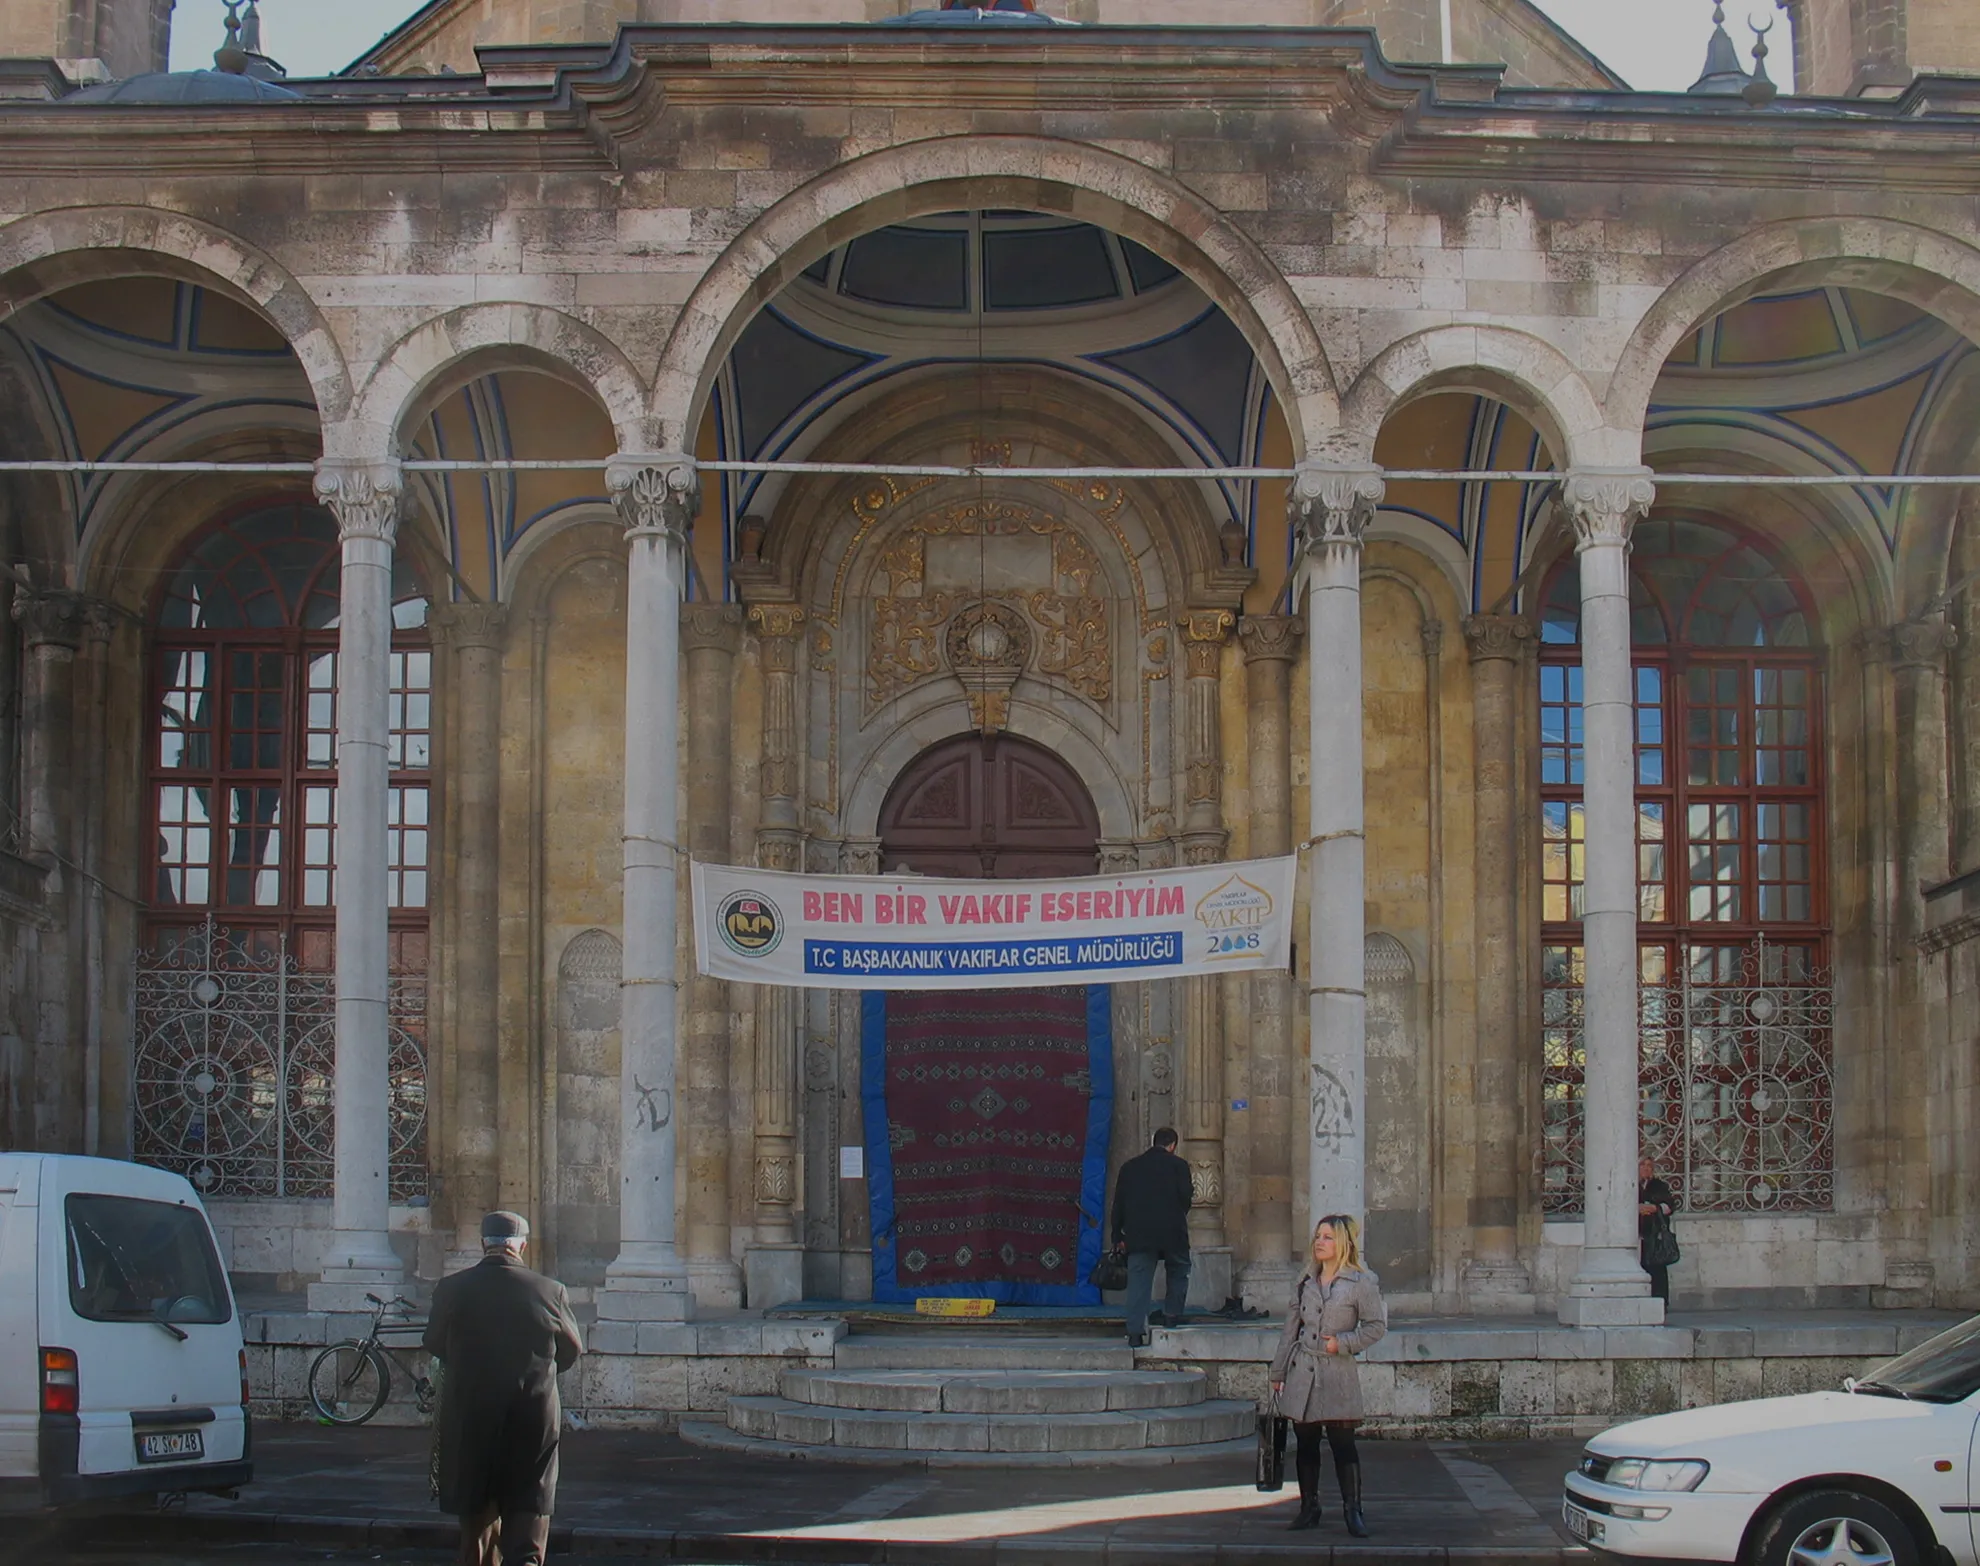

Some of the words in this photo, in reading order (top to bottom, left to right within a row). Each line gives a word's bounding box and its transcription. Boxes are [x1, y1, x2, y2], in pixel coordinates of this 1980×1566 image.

[803, 890, 863, 924] BEN
[875, 885, 927, 925] BİR
[938, 893, 1032, 925] VAKIF
[1040, 879, 1185, 923] ESERİYİM
[812, 947, 836, 969] T.C
[1023, 944, 1072, 967] GENEL
[1076, 935, 1175, 963] MÜDÜRLÜĞÜ
[147, 1436, 159, 1454] 42
[178, 1433, 197, 1451] 748
